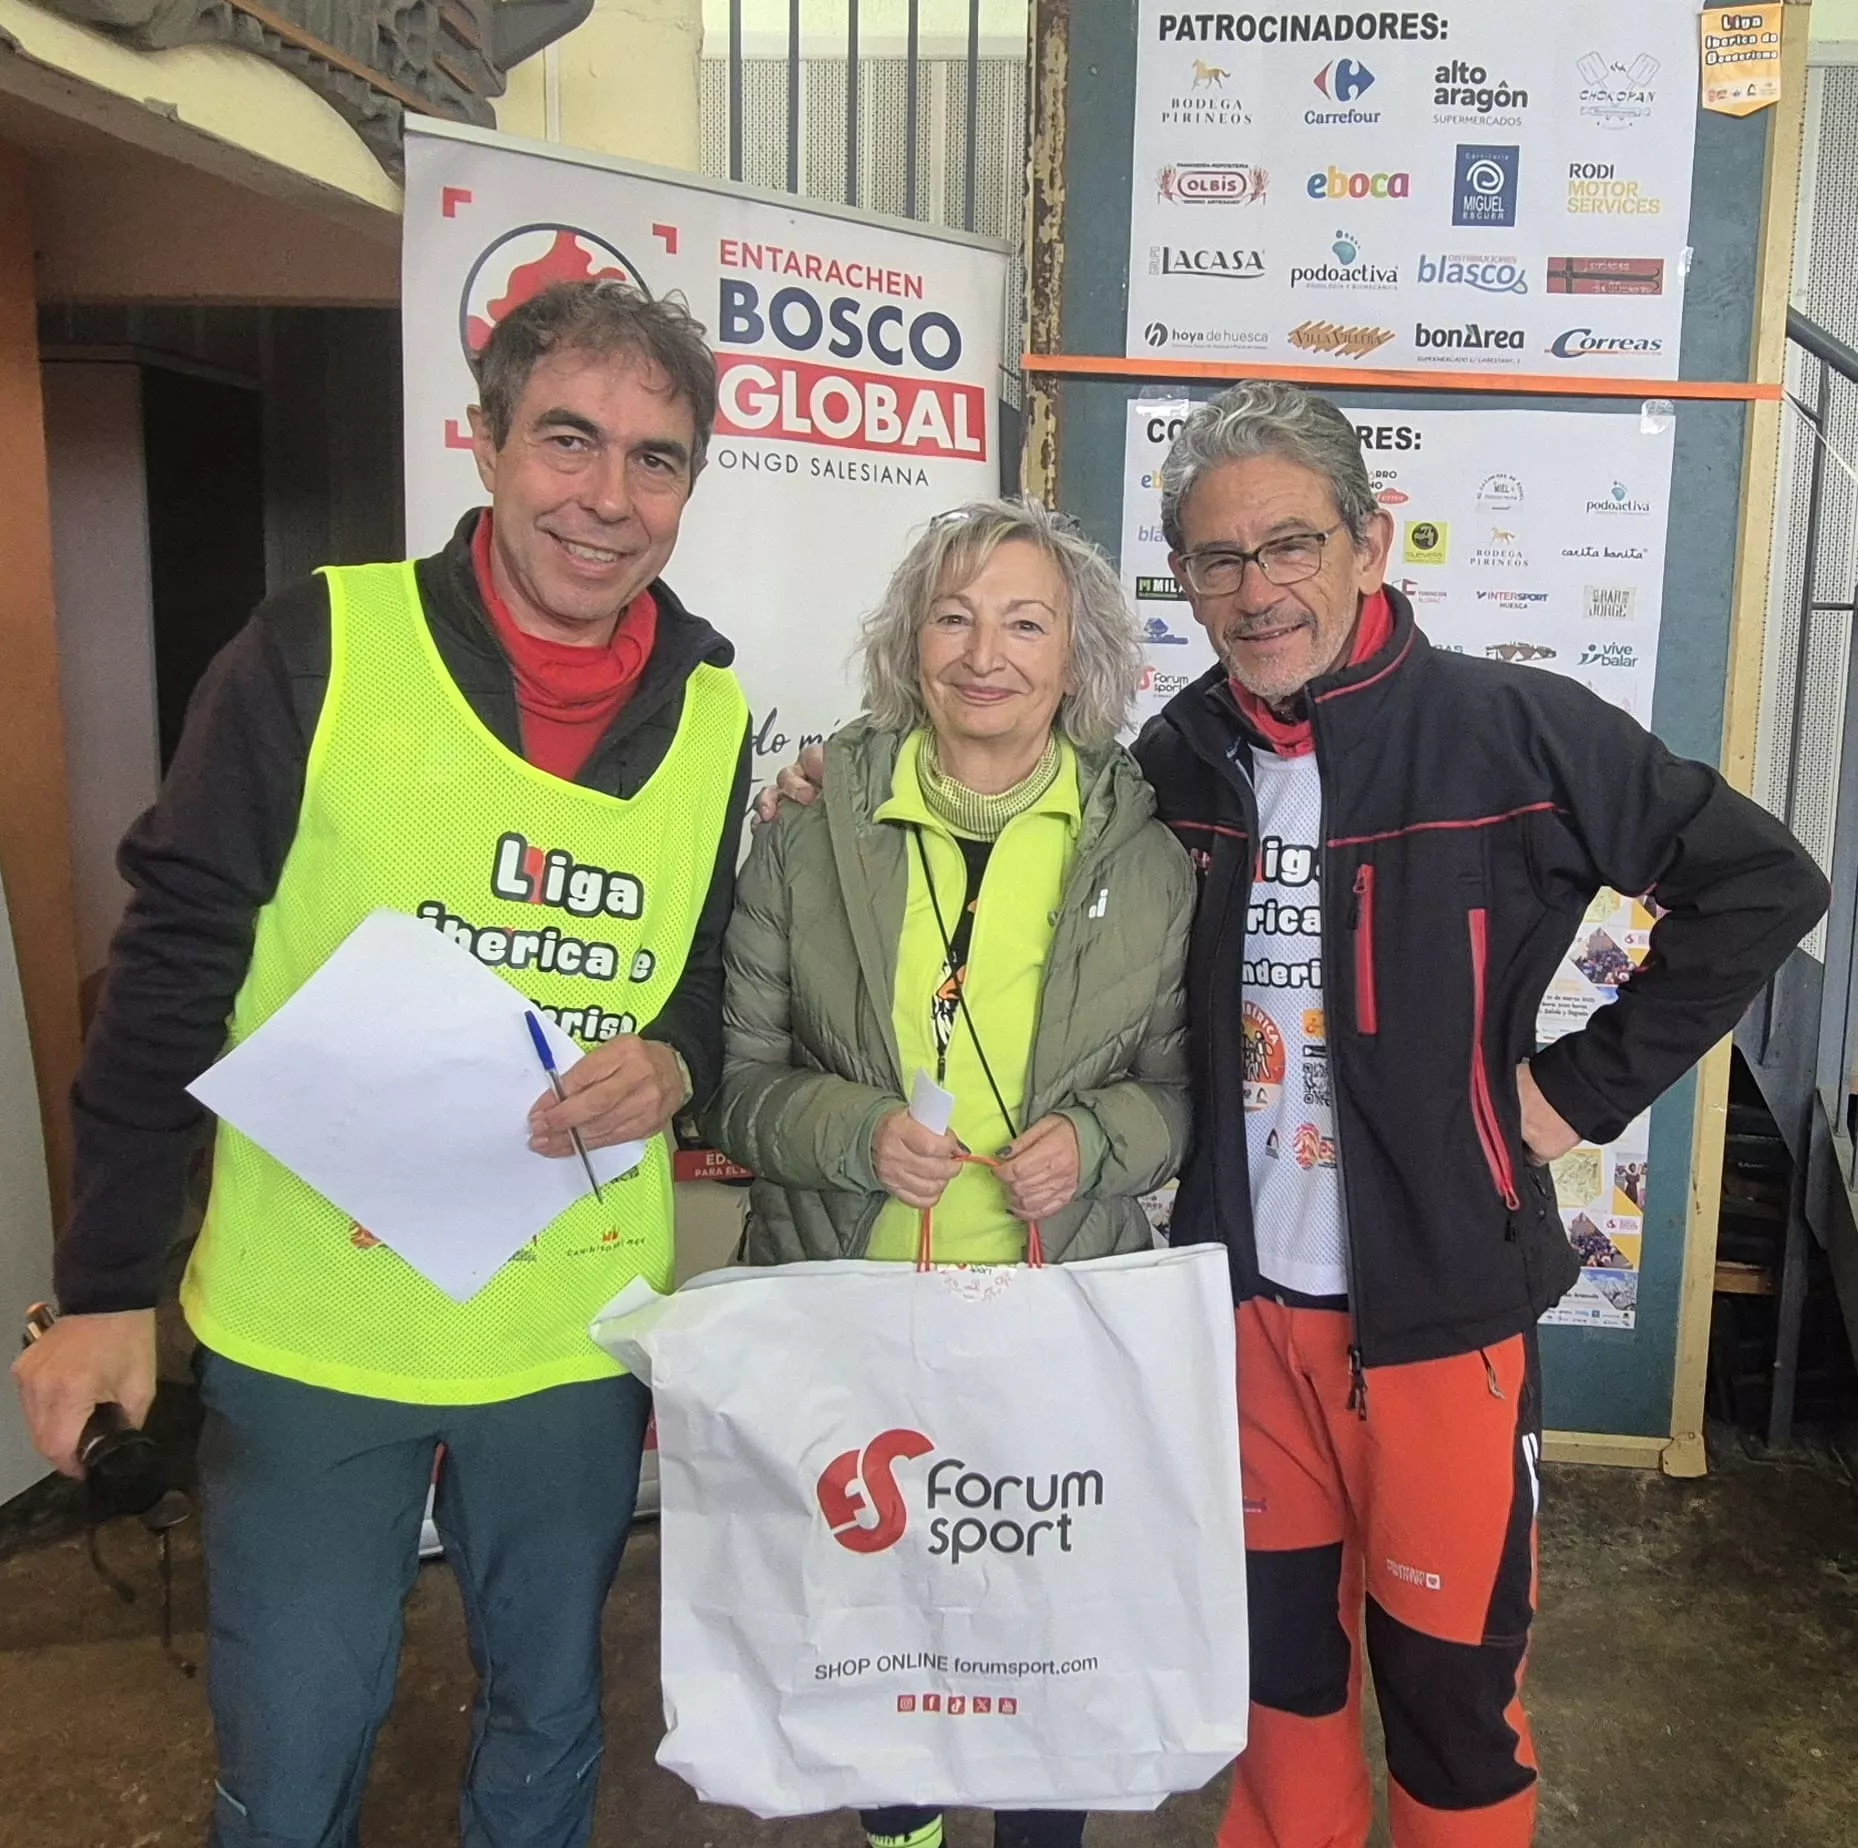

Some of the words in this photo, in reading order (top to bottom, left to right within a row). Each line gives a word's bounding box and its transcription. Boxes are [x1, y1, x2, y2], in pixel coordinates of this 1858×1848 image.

[1159, 12, 1449, 43] PATROCINADORES:
[1435, 60, 1487, 84] alto
[1171, 98, 1242, 110] BODEGA
[1161, 112, 1252, 124] PIRINEOS
[1304, 109, 1381, 125] Carrefour
[1433, 114, 1522, 126] SUPERMERCADOS
[1569, 163, 1614, 179] RODI
[1307, 166, 1409, 199] eboca
[1568, 181, 1639, 197] MOTOR
[1463, 196, 1504, 212] MIGUEL
[1567, 198, 1660, 214] SERVICES
[1162, 247, 1265, 275] LACASA
[720, 240, 923, 299] ENTARACHEN
[1291, 263, 1398, 288] podoactiva
[1417, 254, 1517, 285] blasco
[719, 277, 962, 371] BOSCO
[1172, 329, 1204, 343] hoya
[1206, 329, 1222, 341] de
[1223, 330, 1268, 343] huesca
[1551, 328, 1662, 358] Correas
[718, 364, 981, 453] GLOBAL
[719, 449, 799, 473] ONGD
[811, 458, 929, 487] SALESIANA
[1586, 500, 1649, 513] podoactiva
[1477, 549, 1523, 557] BODEGA
[1470, 558, 1529, 567] PIRINEOS
[1488, 592, 1548, 601] INTERSPORT
[1603, 642, 1632, 655] vive
[1601, 654, 1638, 667] balar
[491, 831, 645, 920] Liga
[695, 1168, 723, 1177] PARA
[726, 1166, 737, 1175] EL
[927, 1513, 1072, 1564] sport
[814, 1658, 871, 1681] SHOP
[876, 1651, 948, 1673] ONLINE
[953, 1655, 1099, 1681] forumsport.com
